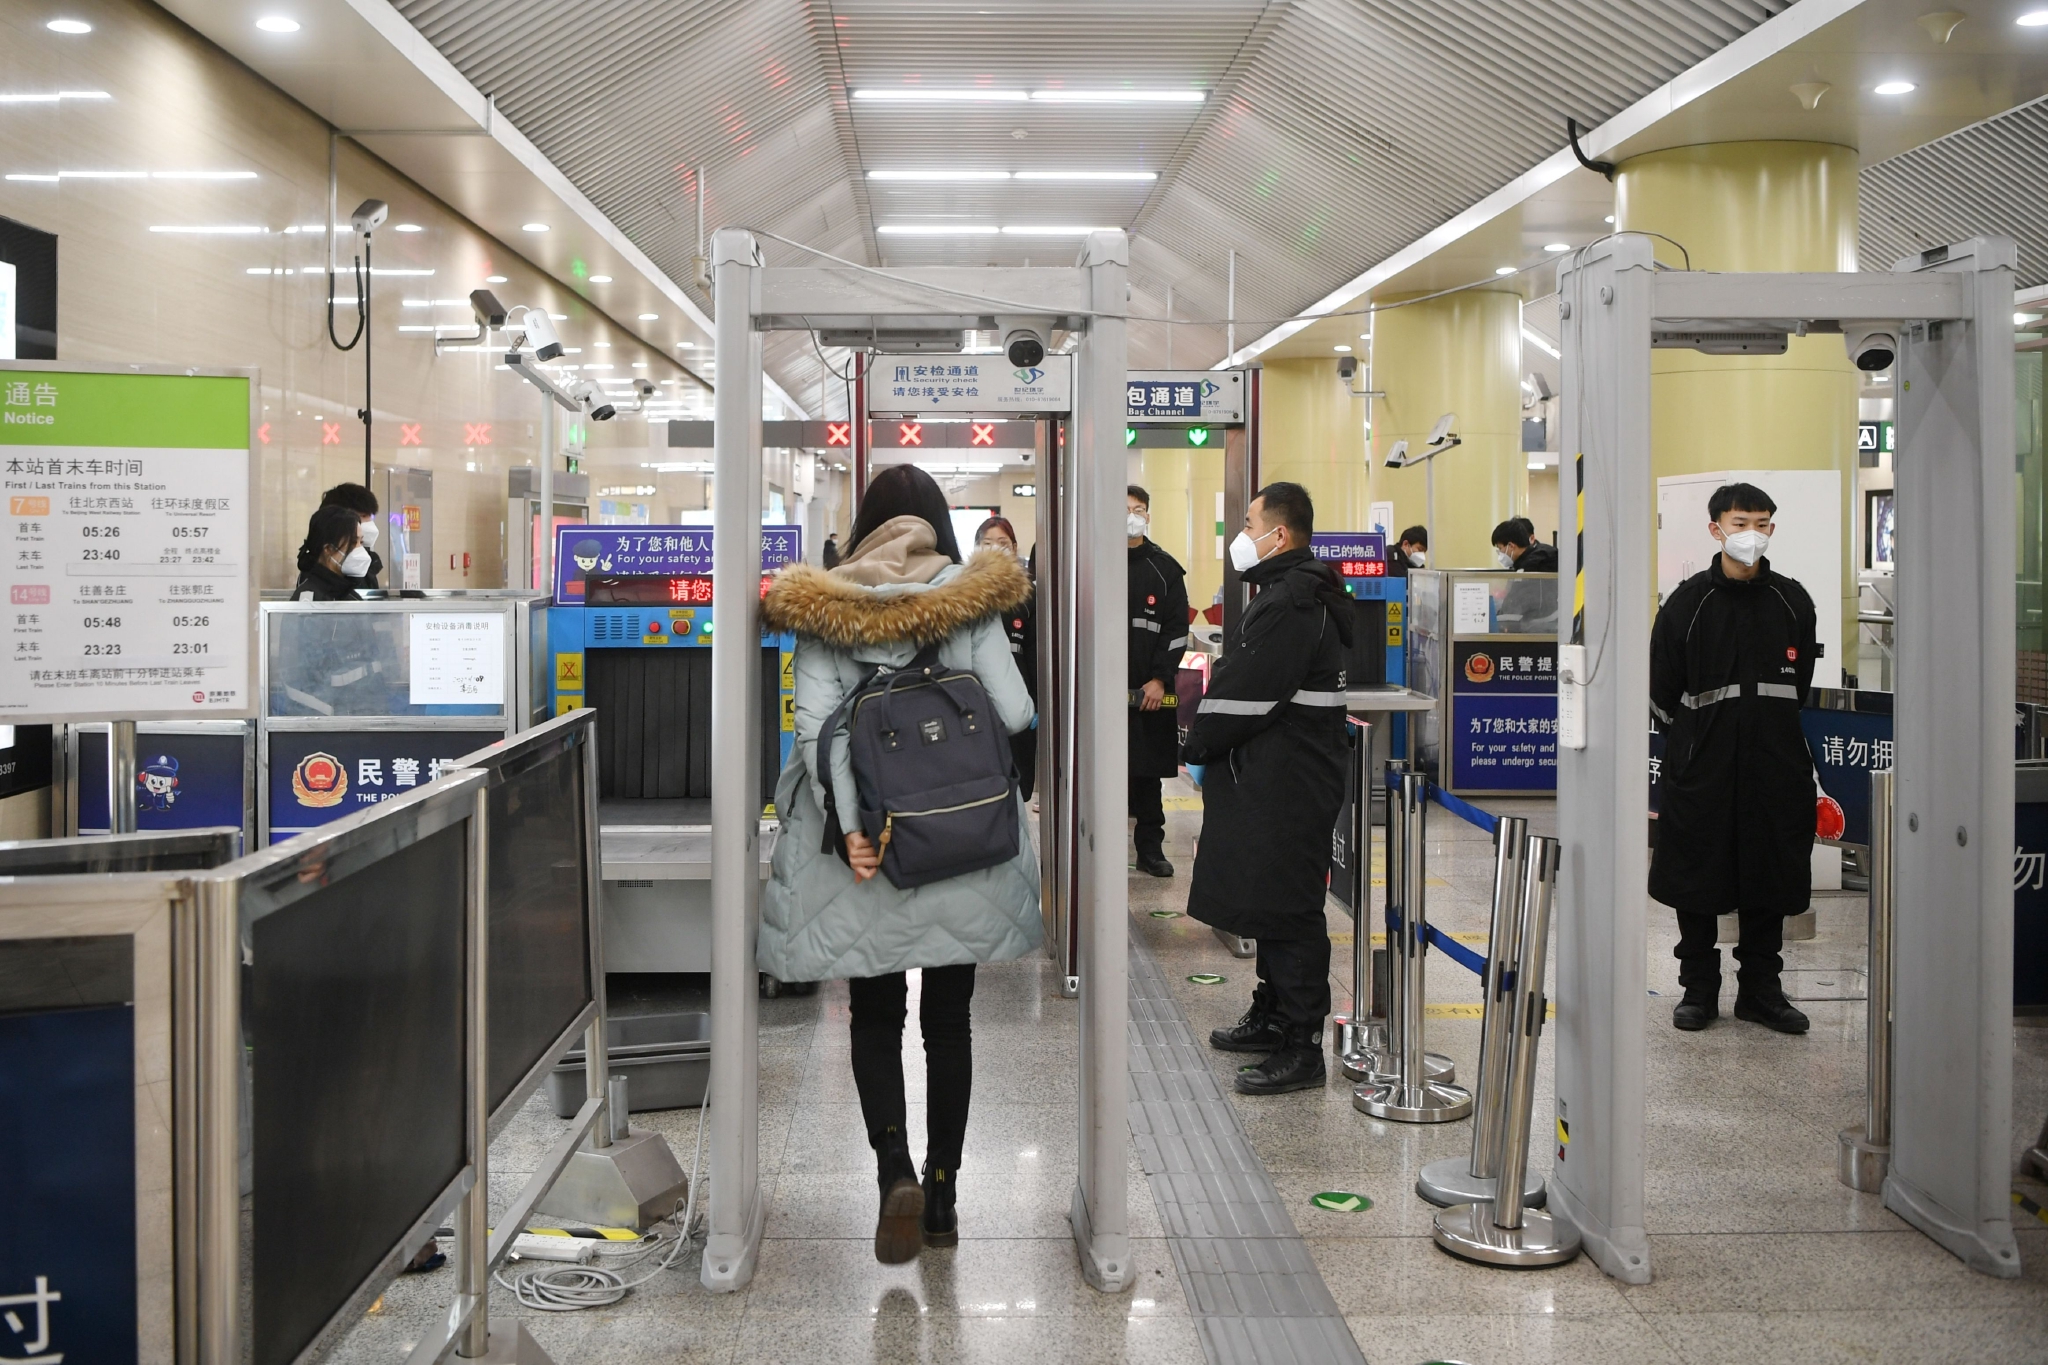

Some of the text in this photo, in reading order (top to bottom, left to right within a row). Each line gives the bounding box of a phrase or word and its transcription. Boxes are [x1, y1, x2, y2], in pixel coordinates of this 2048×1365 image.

[913, 365, 978, 376] 安检通道
[5, 382, 59, 406] 通告
[892, 387, 978, 396] 请您接受安检
[1127, 386, 1194, 406] 包通道
[1128, 408, 1145, 416] Bag
[4, 412, 54, 424] Notice
[1858, 429, 1872, 446] A
[6, 457, 143, 476] 本站首末车时间
[5, 481, 26, 489] First
[35, 482, 56, 490] Last
[58, 482, 87, 490] Trains
[90, 482, 111, 490] from
[114, 482, 130, 490] this
[134, 483, 166, 491] Station
[69, 497, 134, 509] 往北京西站
[151, 498, 230, 510] 往环球度假区
[18, 522, 42, 533] 首车
[83, 527, 120, 537] 05:26
[172, 527, 209, 537] 05:57
[616, 536, 789, 552] 为了您和他人 安全
[18, 550, 42, 561] 末车
[83, 550, 120, 560] 23:40
[618, 554, 635, 563] For
[639, 555, 664, 566] your
[668, 554, 701, 565] safety
[768, 554, 789, 563] ride
[669, 580, 713, 601] 请您
[16, 614, 40, 625] 首车
[84, 617, 121, 628] 05:48
[173, 616, 210, 627] 05:26
[426, 622, 489, 630] 安检设备消毒说明
[16, 642, 40, 652] 末车
[84, 644, 122, 655] 23:23
[173, 643, 208, 654] 23:01
[1500, 656, 1558, 672] 民警提
[30, 667, 205, 681] 请在末班车离站前十分钟进站乘车
[1470, 718, 1558, 734] 为了您和大家的安
[1472, 742, 1555, 754] For your safety and
[1822, 736, 1893, 768] 请勿拥
[1471, 756, 1496, 767] please
[1502, 756, 1535, 768] undergo
[356, 793, 377, 802] THE
